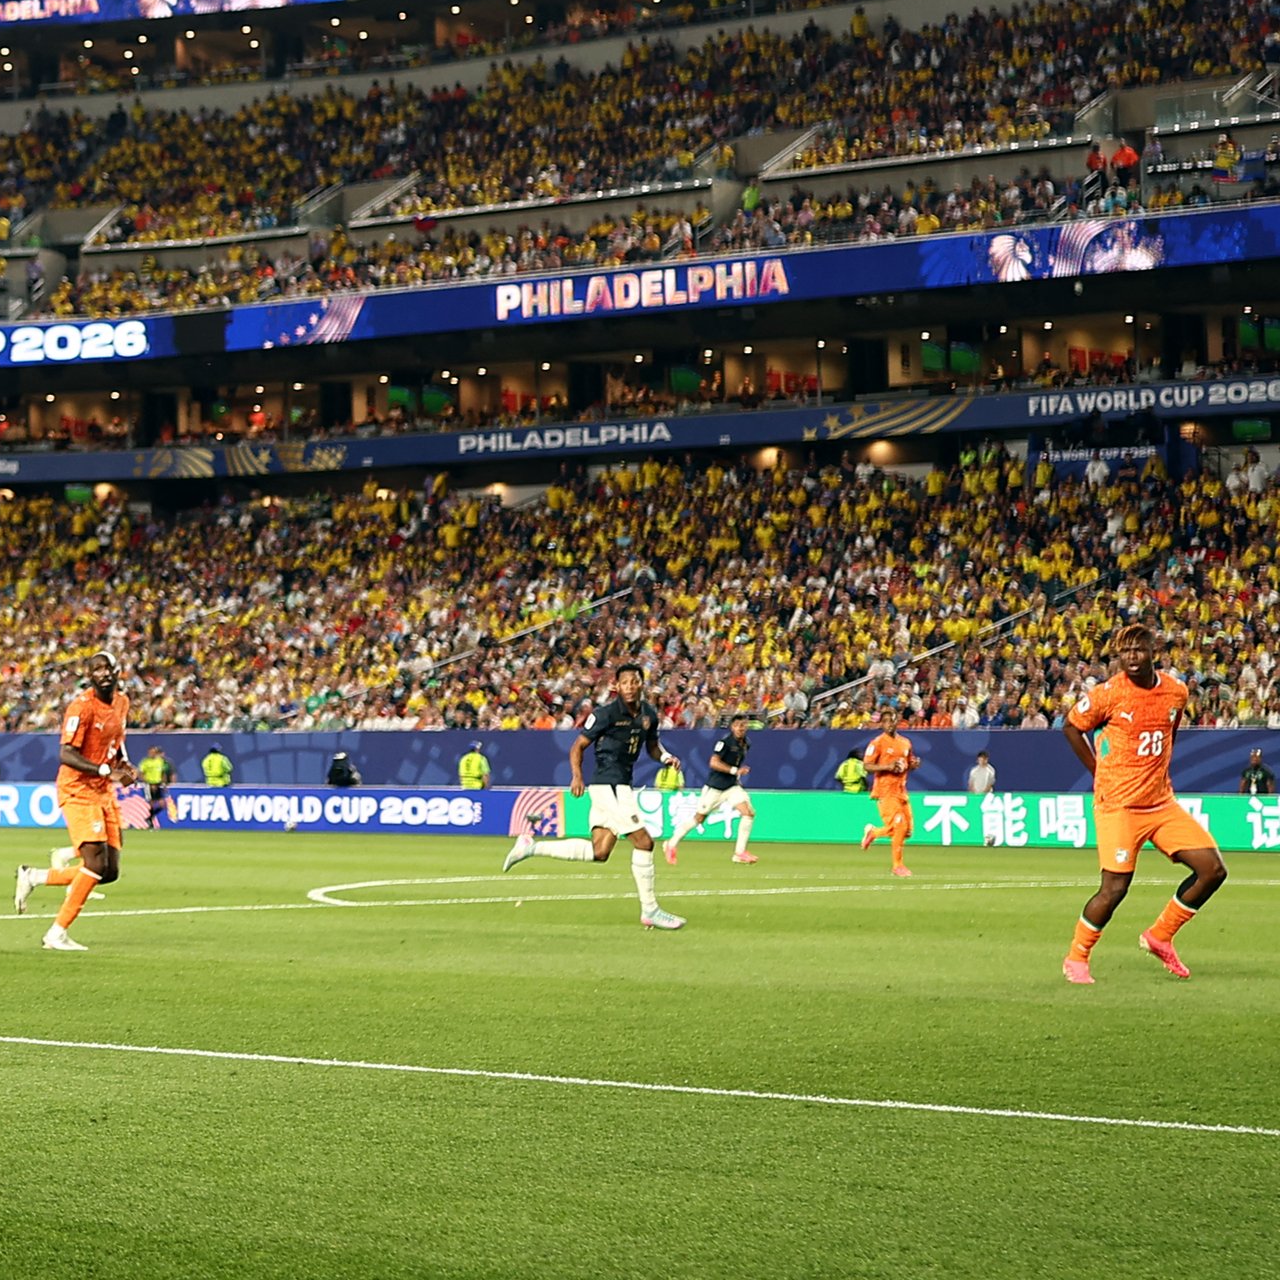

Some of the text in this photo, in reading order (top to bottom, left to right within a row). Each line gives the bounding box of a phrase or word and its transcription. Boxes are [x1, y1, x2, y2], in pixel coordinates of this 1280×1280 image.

[495, 258, 790, 322] PHILADELPHIA
[11, 322, 147, 362] 2026
[1028, 380, 1280, 417] FIFA WORLD CUP 2026
[458, 422, 672, 454] PHILADELPHIA
[177, 794, 229, 823] FIFA
[229, 795, 323, 823] WORLD
[324, 796, 378, 824] CUP
[379, 797, 474, 826] 2026
